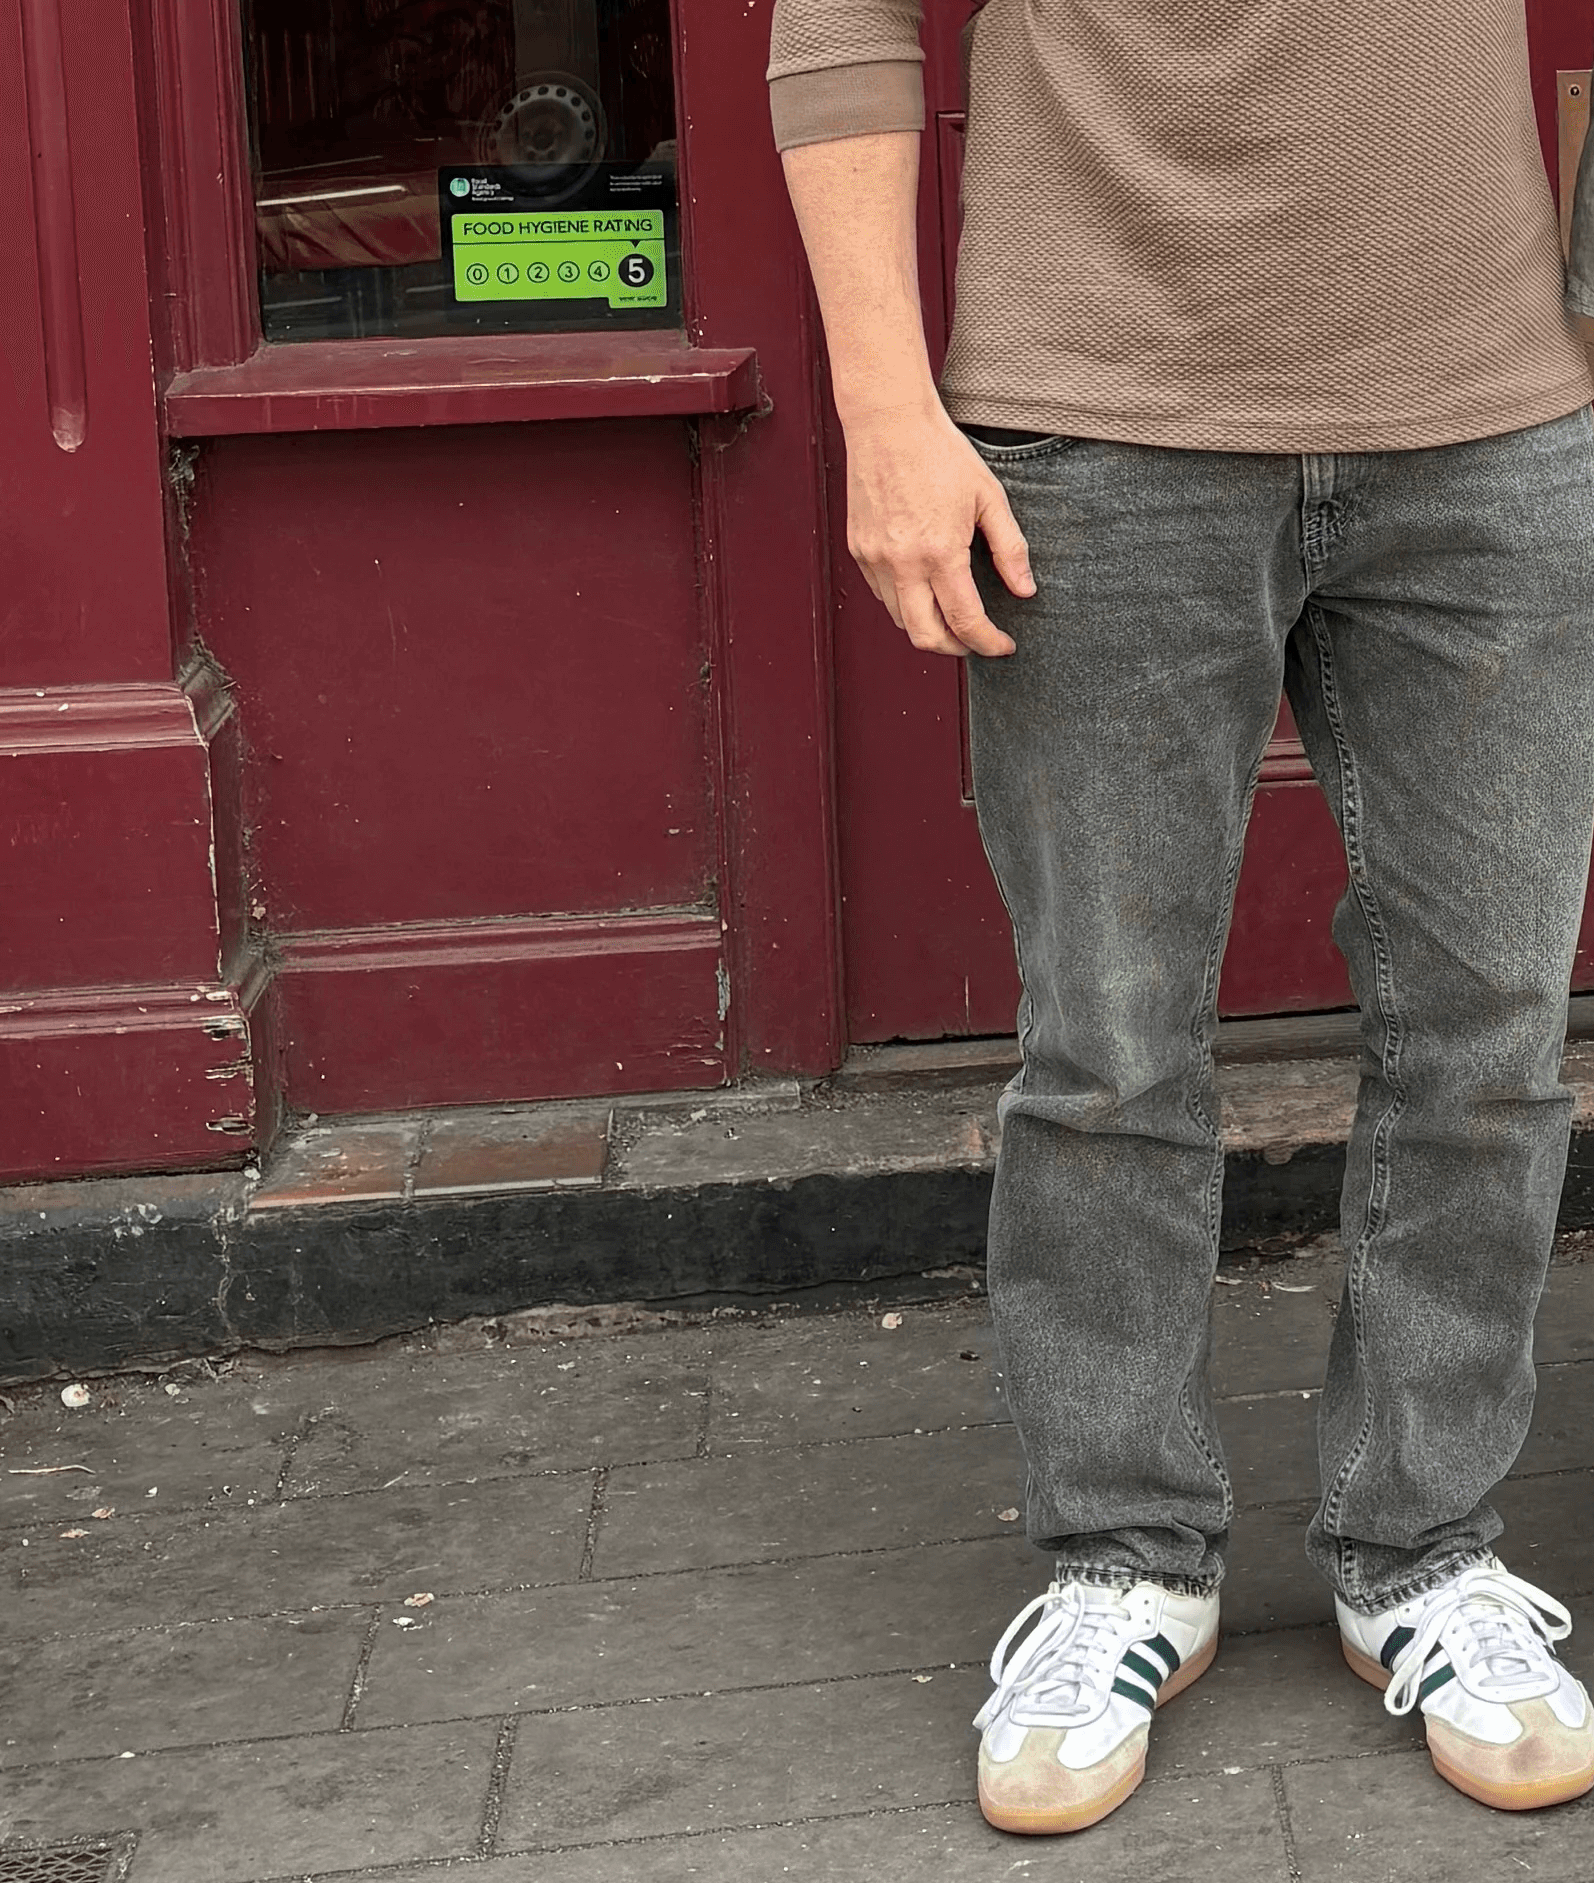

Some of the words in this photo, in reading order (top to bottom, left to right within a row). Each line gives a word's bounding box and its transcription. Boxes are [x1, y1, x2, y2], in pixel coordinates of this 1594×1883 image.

[463, 222, 514, 236] FOOD
[519, 219, 590, 235] HYGIENE
[593, 218, 653, 233] RATING
[627, 257, 646, 284] 5
